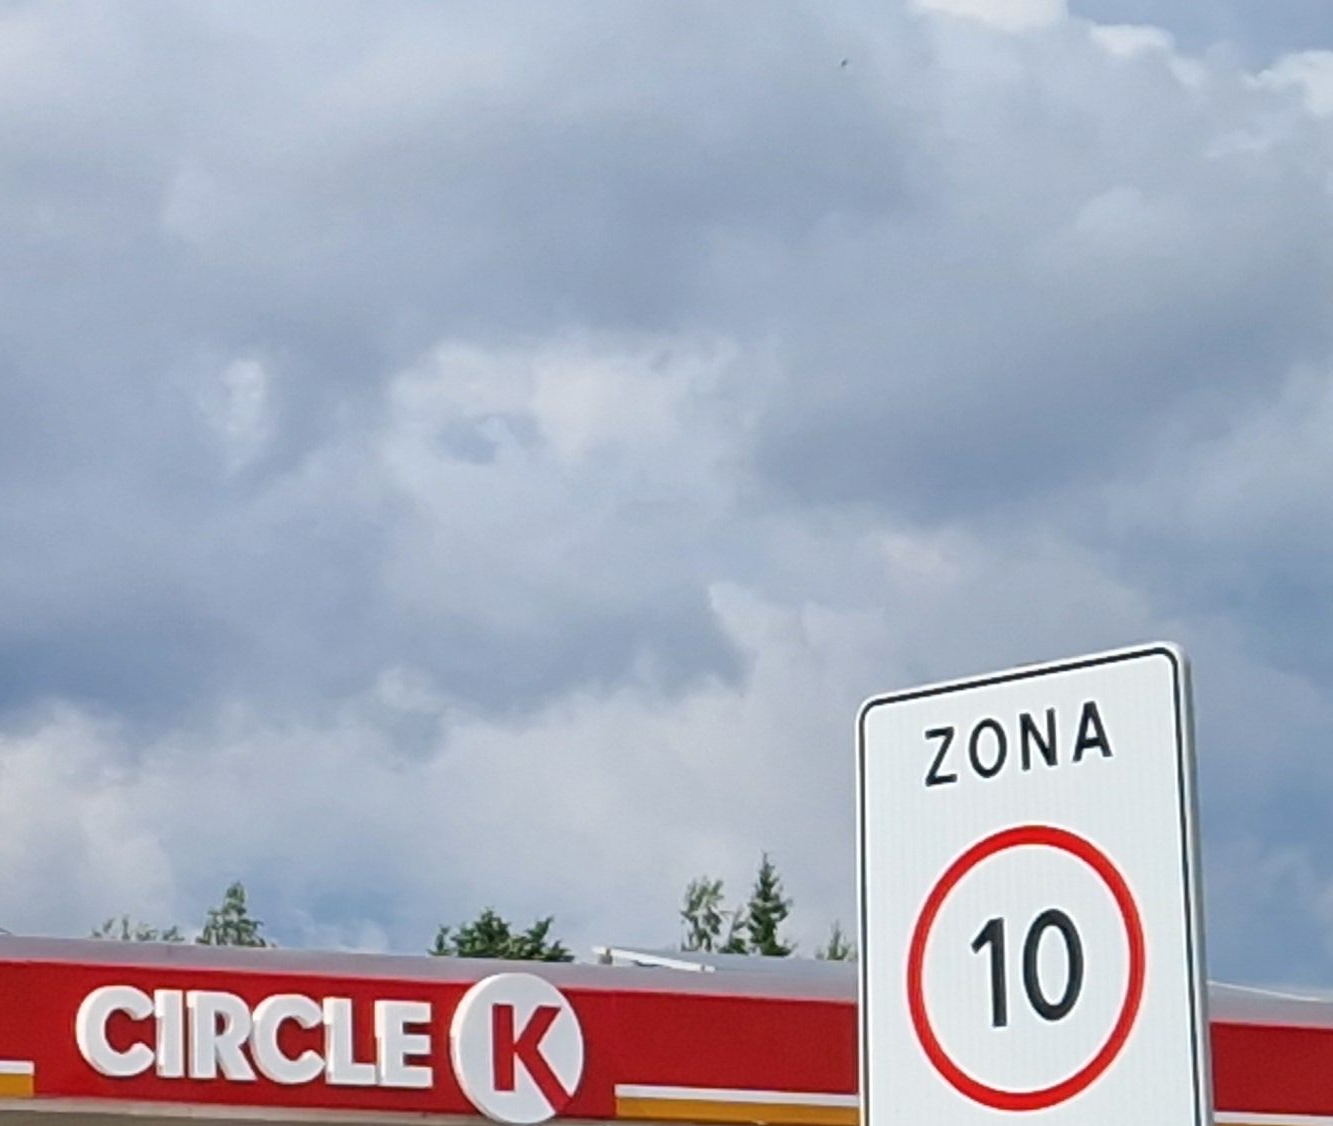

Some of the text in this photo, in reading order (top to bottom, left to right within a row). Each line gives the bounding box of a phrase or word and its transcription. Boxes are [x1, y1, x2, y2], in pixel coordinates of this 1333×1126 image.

[923, 699, 1114, 788] ZONA
[970, 907, 1085, 1028] 10
[75, 984, 434, 1089] CIRCLE
